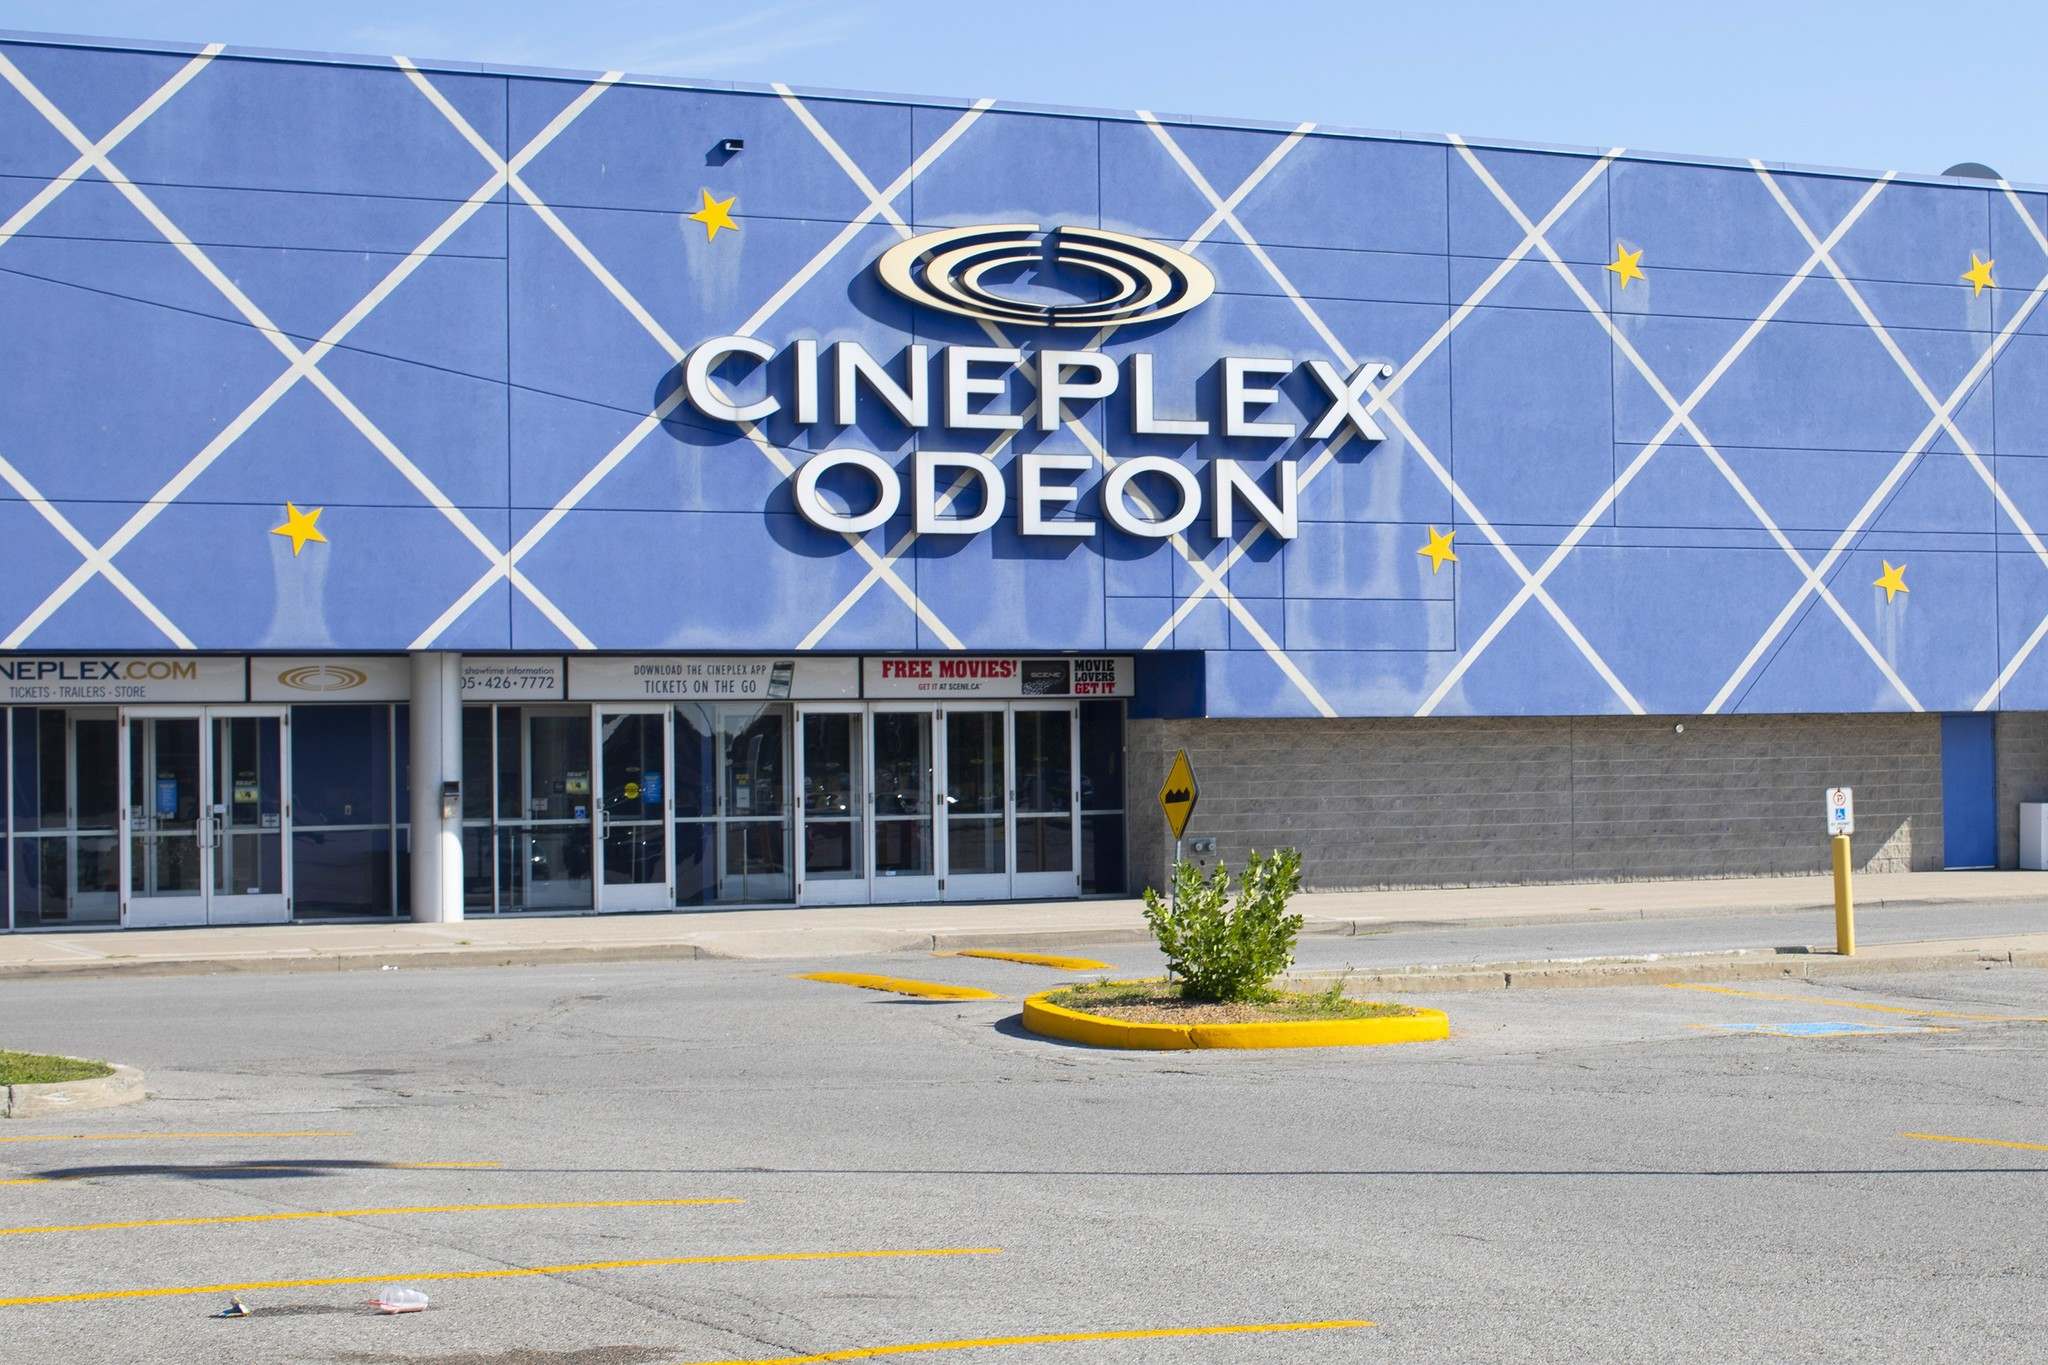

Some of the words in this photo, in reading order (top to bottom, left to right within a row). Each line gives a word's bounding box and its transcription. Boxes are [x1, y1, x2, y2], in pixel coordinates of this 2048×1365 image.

[682, 335, 1388, 441] CINEPLEX
[792, 449, 1298, 539] ODEON
[464, 665, 504, 675] showtime
[506, 665, 555, 675] information
[633, 664, 682, 676] DOWNLOAD
[687, 664, 702, 676] THE
[706, 664, 747, 676] CINEPLEX
[751, 664, 767, 676] APP
[882, 660, 932, 679] FREE
[939, 659, 1018, 679] MOVIES!
[1074, 660, 1114, 671] MOVIE
[1074, 672, 1116, 682] LOVERS
[10, 686, 50, 698] TICKETS
[59, 686, 106, 698] TRAILERS
[114, 686, 146, 698] STORE
[645, 680, 687, 694] TICKETS
[693, 680, 709, 694] ON
[715, 680, 735, 694] THE
[741, 680, 757, 693] GO
[1075, 682, 1099, 694] GET
[1101, 682, 1116, 694] IT
